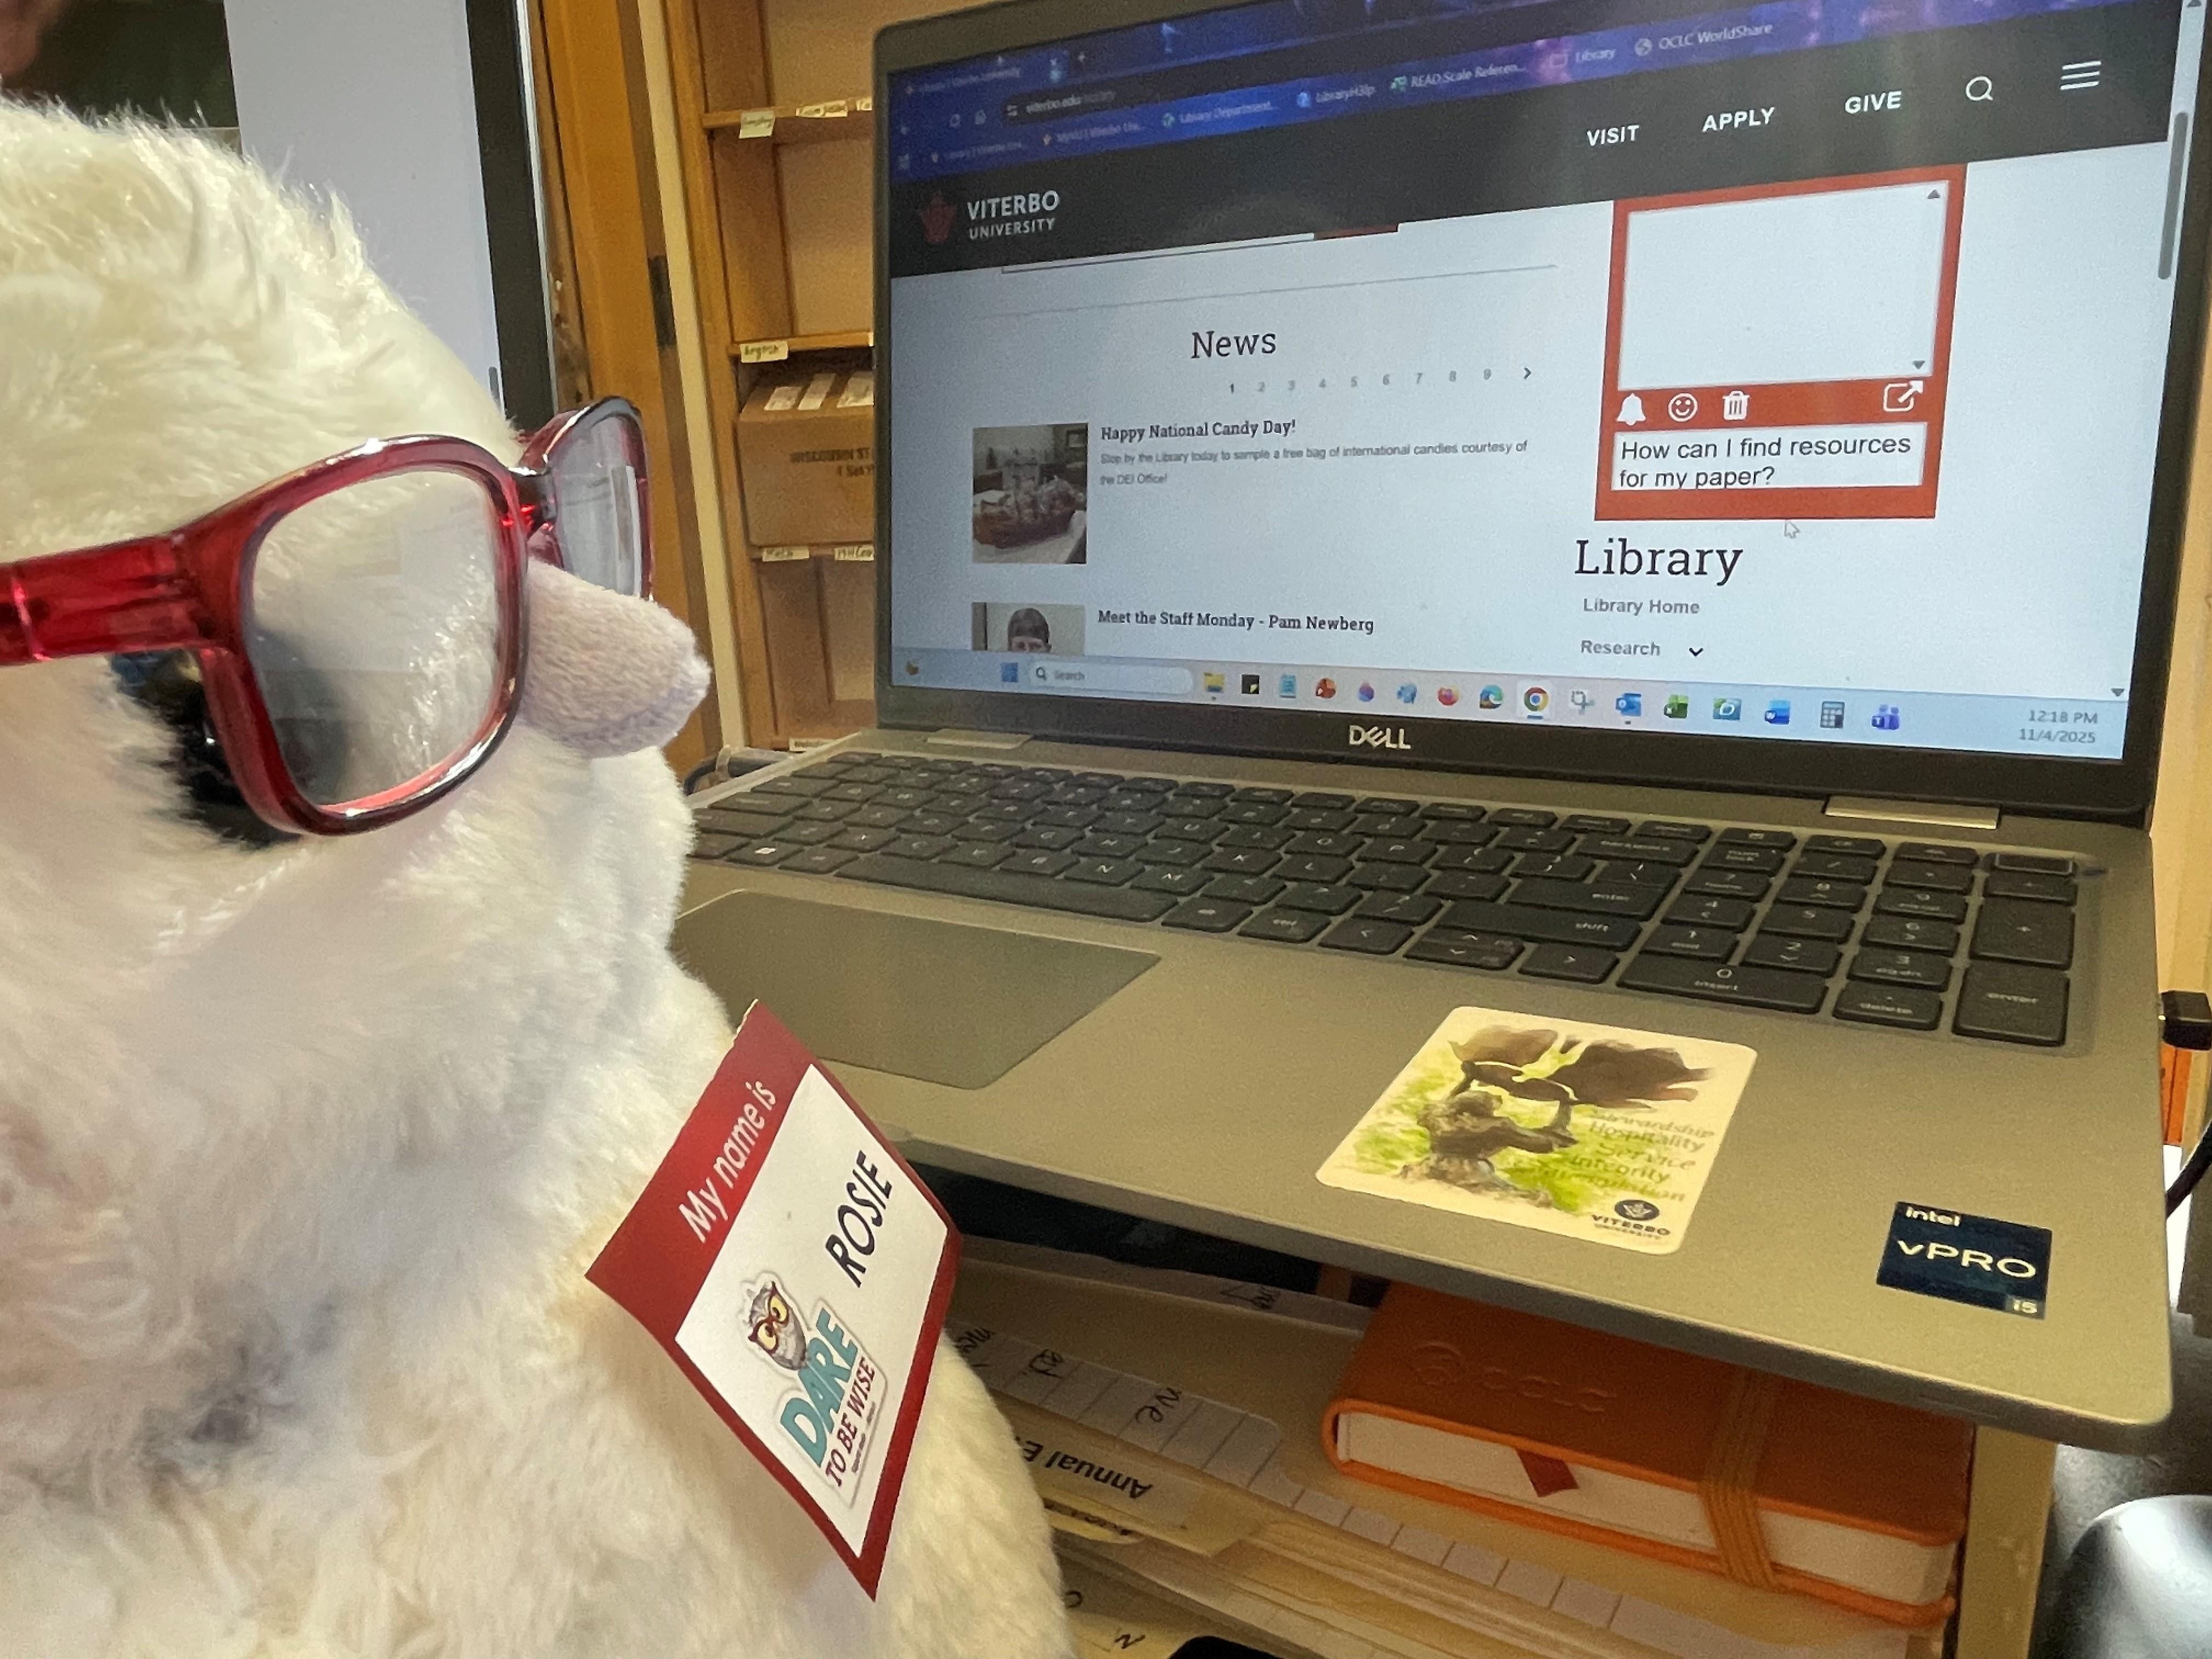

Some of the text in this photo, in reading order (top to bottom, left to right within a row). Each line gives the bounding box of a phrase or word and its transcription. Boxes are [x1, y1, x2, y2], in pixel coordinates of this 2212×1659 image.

[1658, 22, 1773, 50] OCLC WorldShare
[1845, 90, 1903, 115] GIVE
[1702, 107, 1775, 132] APPLY
[1587, 125, 1639, 146] VISIT
[967, 190, 1060, 221] VITERBO
[969, 219, 1056, 240] UNIVERSITY
[1190, 330, 1277, 359] News
[1382, 374, 1390, 386] 6
[1415, 373, 1423, 385] 7
[1449, 370, 1457, 382] 8
[1483, 369, 1492, 380] 9
[1100, 419, 1296, 443] Happy National Candy Day!
[1155, 452, 1189, 464] Library
[1191, 450, 1218, 463] today
[1221, 450, 1231, 461] to
[1233, 449, 1271, 462] sample
[1273, 450, 1280, 460] a
[1283, 447, 1304, 459] free
[1306, 447, 1327, 461] bag
[1329, 445, 1340, 458] of
[1342, 443, 1410, 458] international
[1413, 441, 1458, 455] candies
[1461, 440, 1512, 456] courtesy
[1515, 439, 1528, 453] of
[1621, 436, 1912, 460] How can I find resources
[1620, 465, 1775, 489] for my paper?
[1575, 537, 1744, 586] Library
[1582, 597, 1700, 616] Library Home
[1098, 609, 1132, 625] Meet
[1135, 610, 1158, 626] the
[1160, 611, 1194, 627] Staff
[1197, 612, 1255, 631] Monday
[1268, 614, 1302, 630] Pam
[1306, 615, 1374, 635] Newberg
[1580, 639, 1661, 656] Research
[2029, 709, 2098, 725] 12:18 PM
[1349, 725, 1412, 751] DELL
[2019, 728, 2096, 744] 11/4/2025
[678, 1080, 777, 1244] My name is
[825, 1149, 894, 1289] ROSIE
[1905, 1206, 1961, 1227] intel
[1897, 1239, 2036, 1278] vPRO
[780, 1307, 859, 1469] DARE
[846, 1356, 876, 1417] WISE
[836, 1412, 859, 1453] BE
[825, 1447, 847, 1488] TO
[1044, 1451, 1153, 1500] Annual
